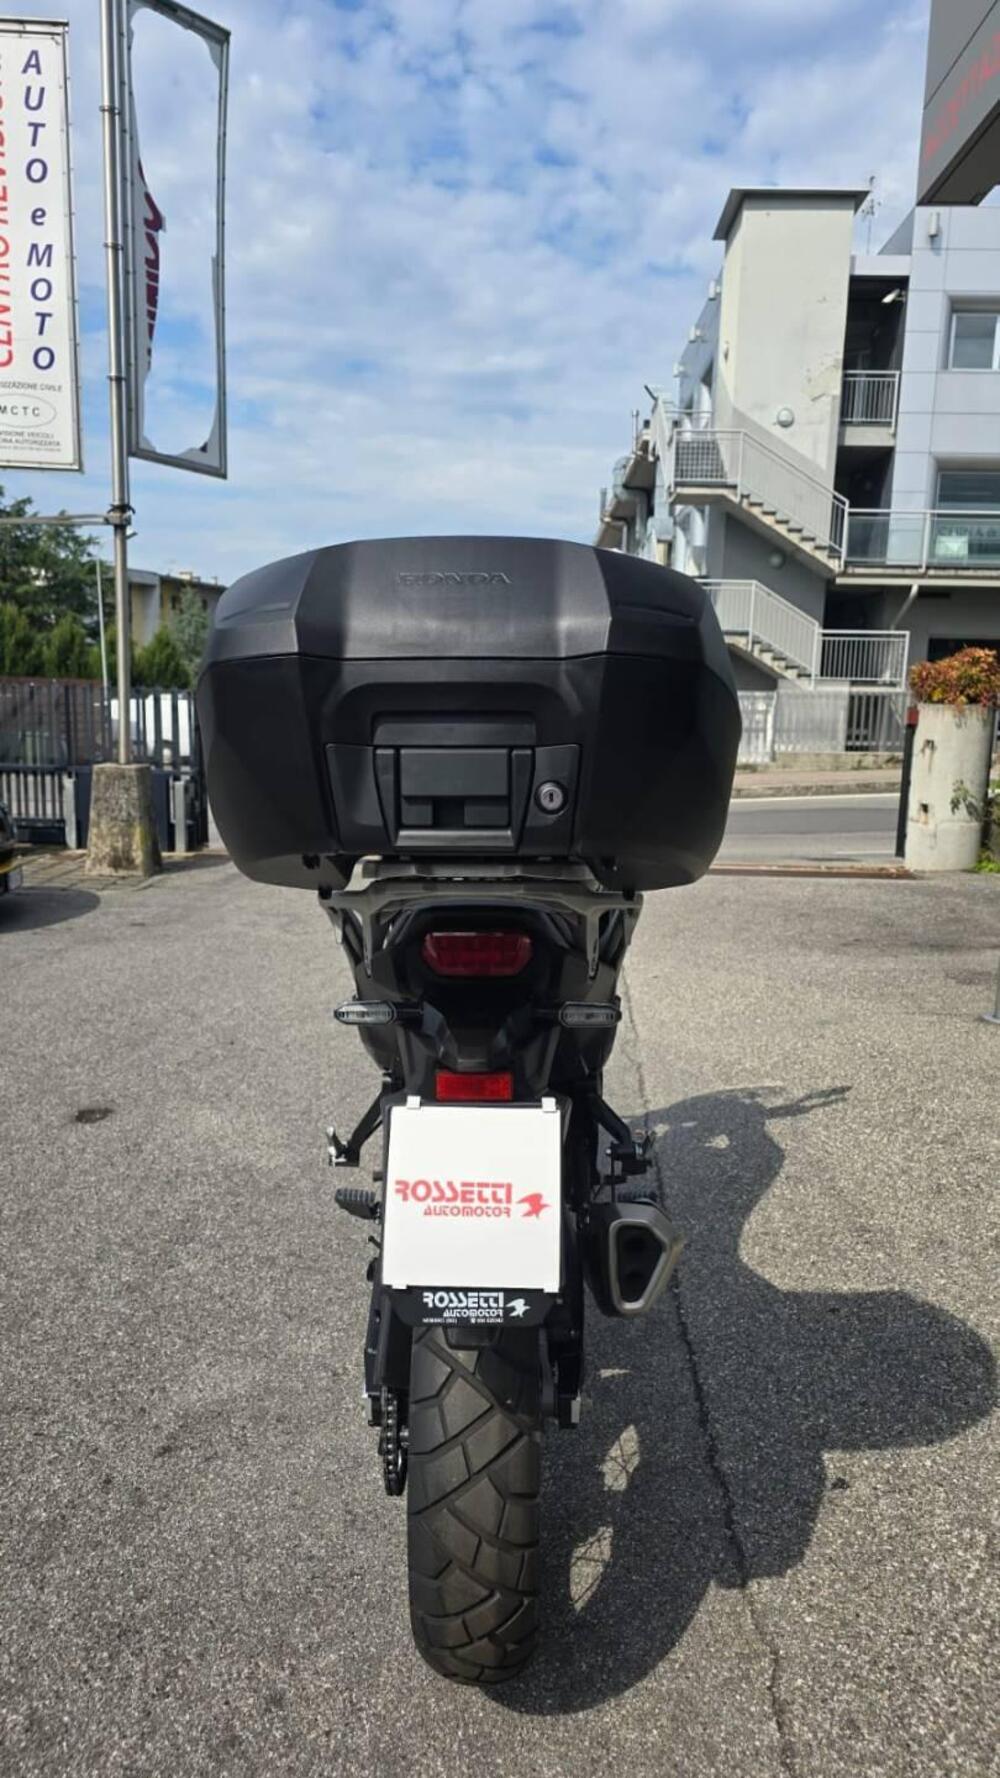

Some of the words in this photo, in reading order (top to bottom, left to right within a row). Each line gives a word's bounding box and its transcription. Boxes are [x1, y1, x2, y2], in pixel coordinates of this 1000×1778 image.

[21, 49, 49, 184] AUTO
[27, 243, 56, 371] MOTO
[395, 1179, 513, 1204] ROSSETTI
[423, 1204, 511, 1218] AUTOMOTOR
[422, 1291, 504, 1308] ROSSETTI
[443, 1308, 504, 1318] AUTOMOTOR
